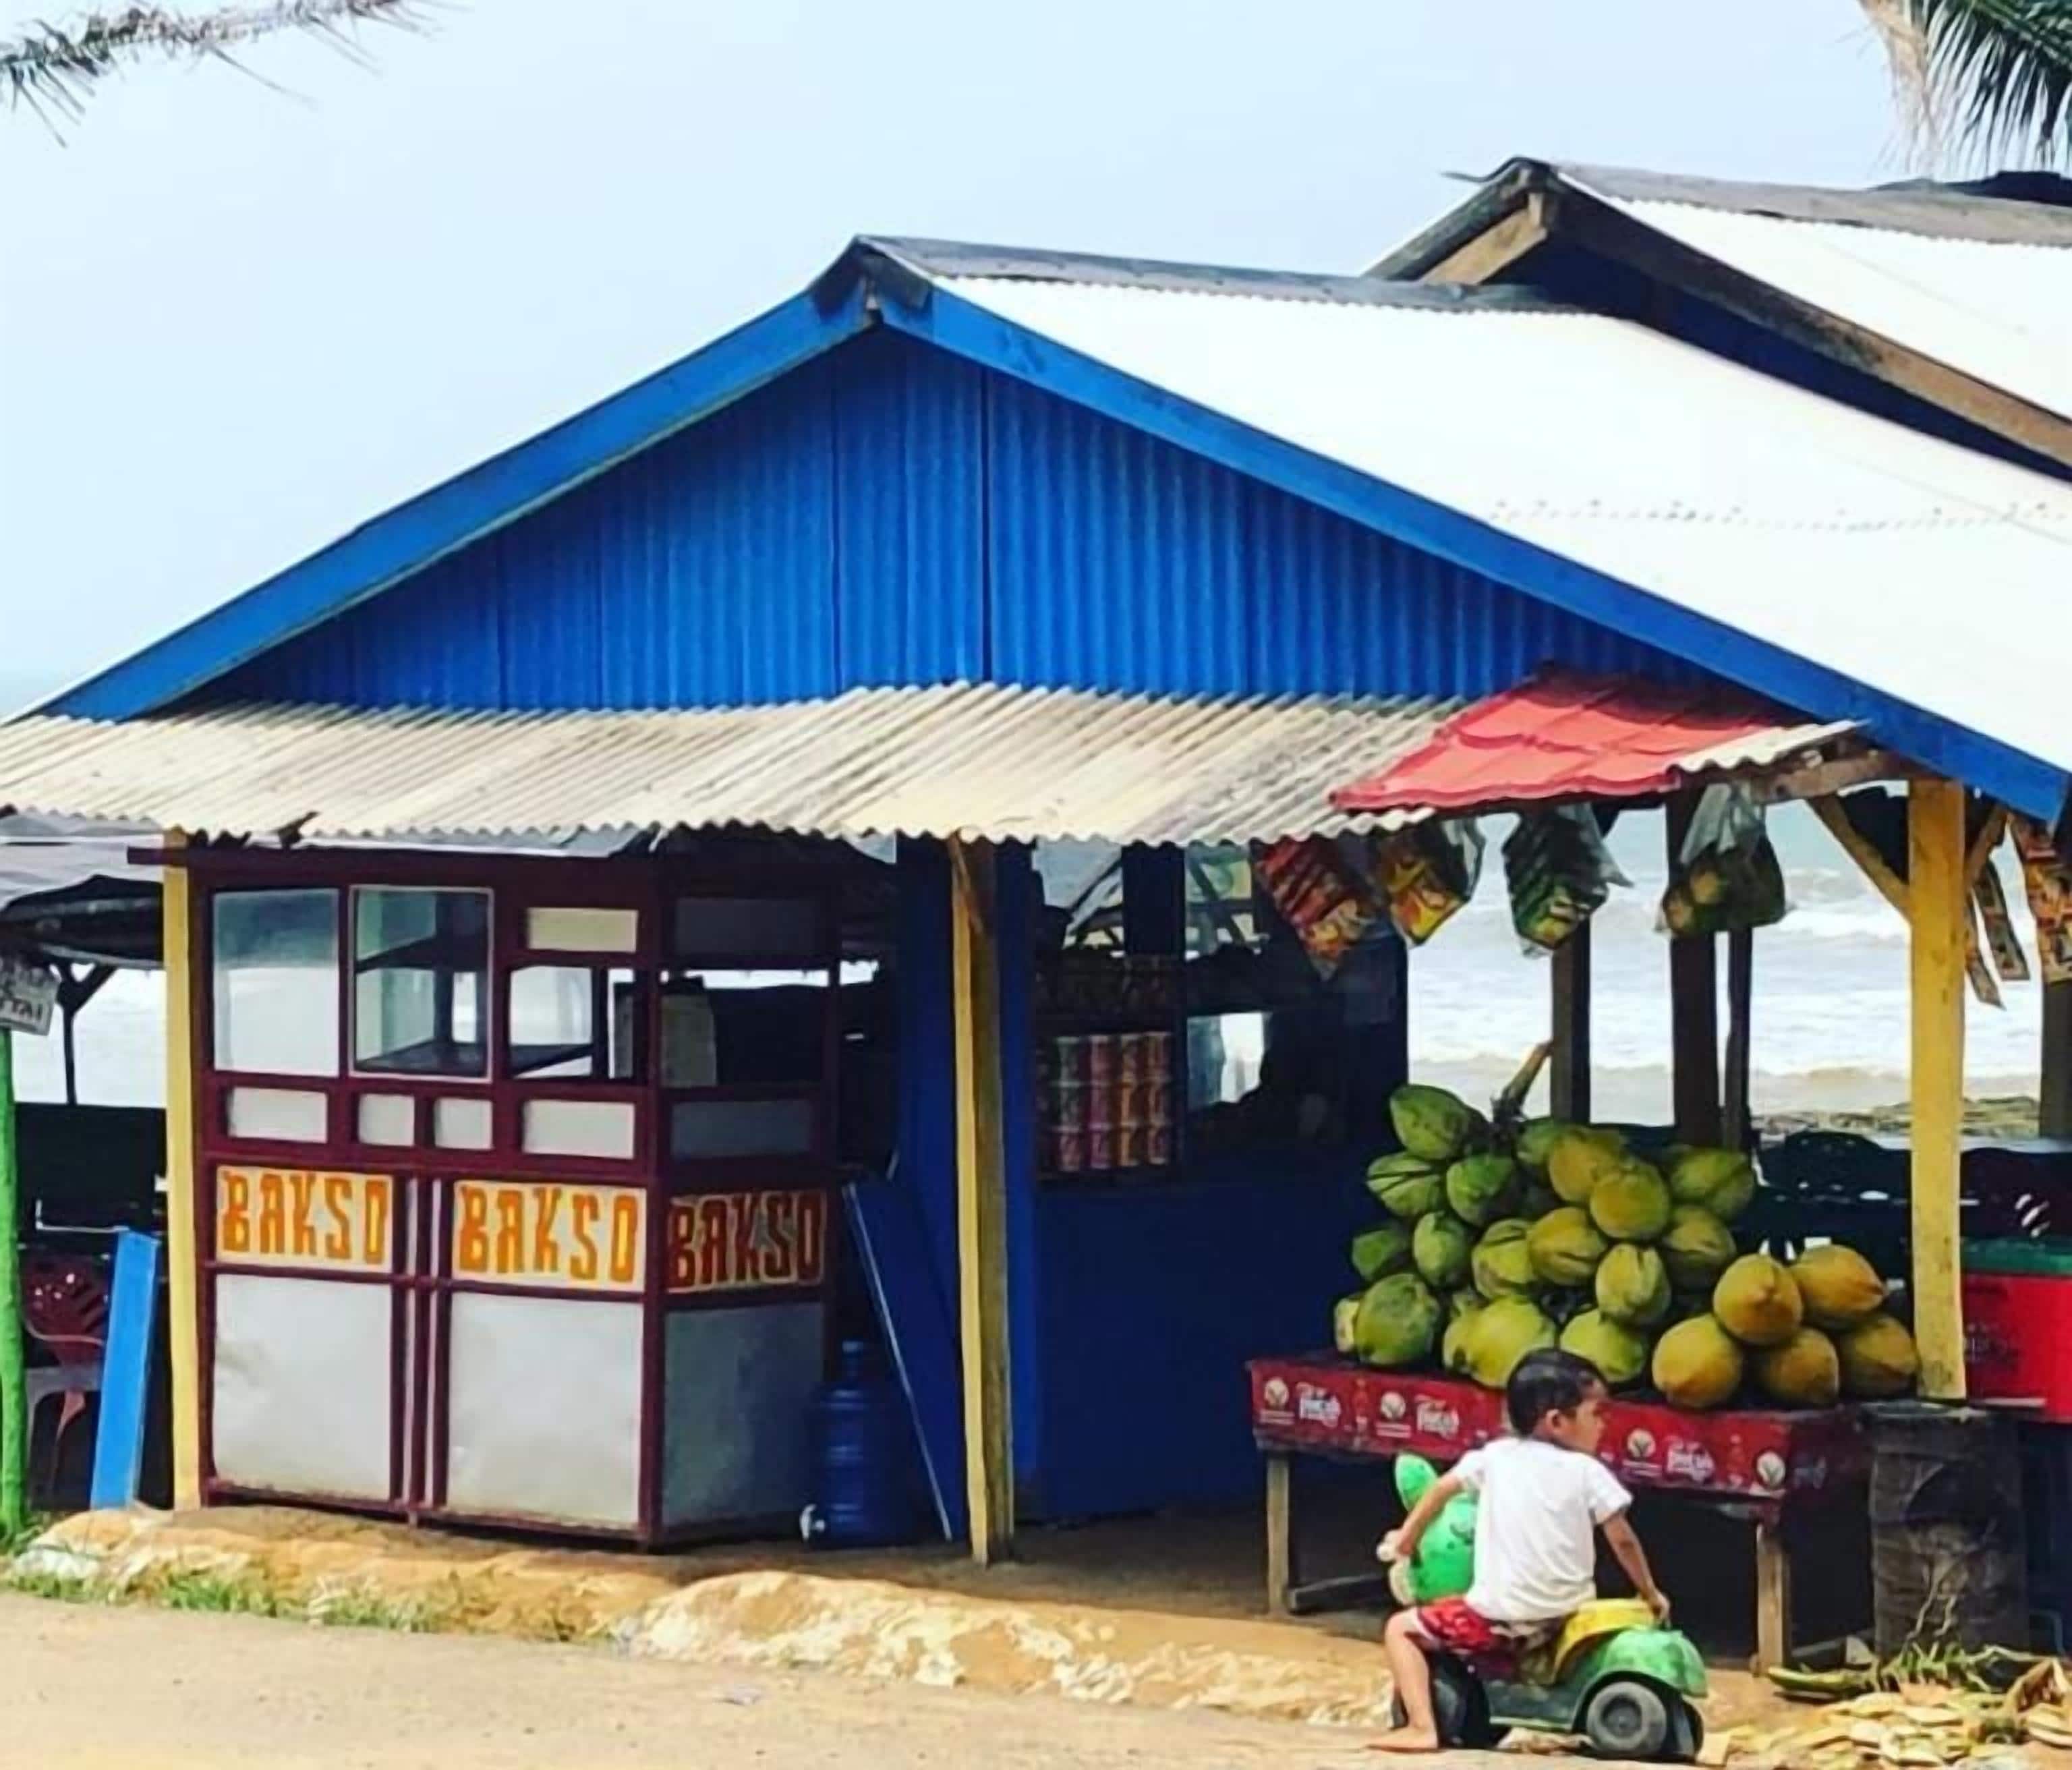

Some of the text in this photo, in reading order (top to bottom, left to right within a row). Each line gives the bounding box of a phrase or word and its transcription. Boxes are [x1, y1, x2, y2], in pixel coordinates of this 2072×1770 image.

[222, 1170, 388, 1265] BAKSO
[459, 1184, 638, 1283] BAKSO
[668, 1192, 823, 1288] BAKSO
